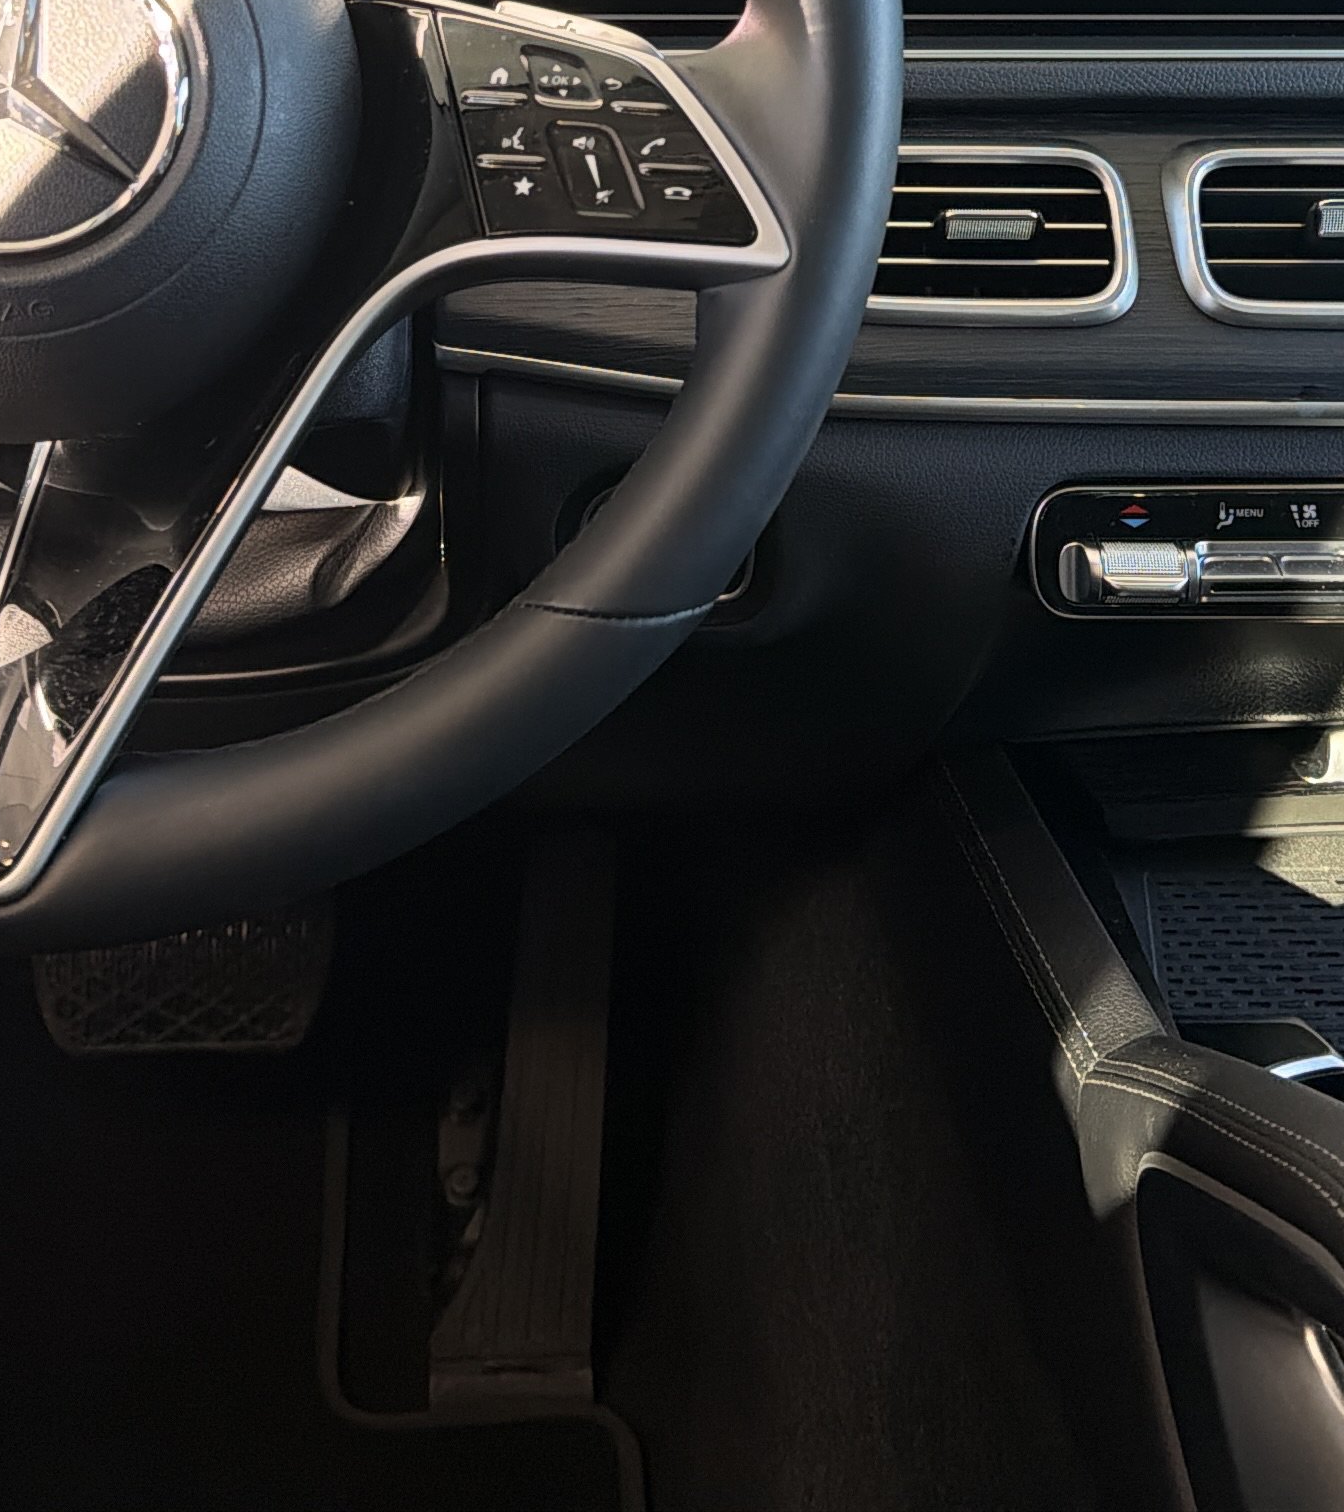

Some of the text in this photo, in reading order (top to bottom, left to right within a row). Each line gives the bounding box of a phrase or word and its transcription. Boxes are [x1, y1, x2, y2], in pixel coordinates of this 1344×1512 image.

[551, 74, 570, 86] OK
[1236, 508, 1264, 518] MENU
[1301, 519, 1320, 528] OFF
